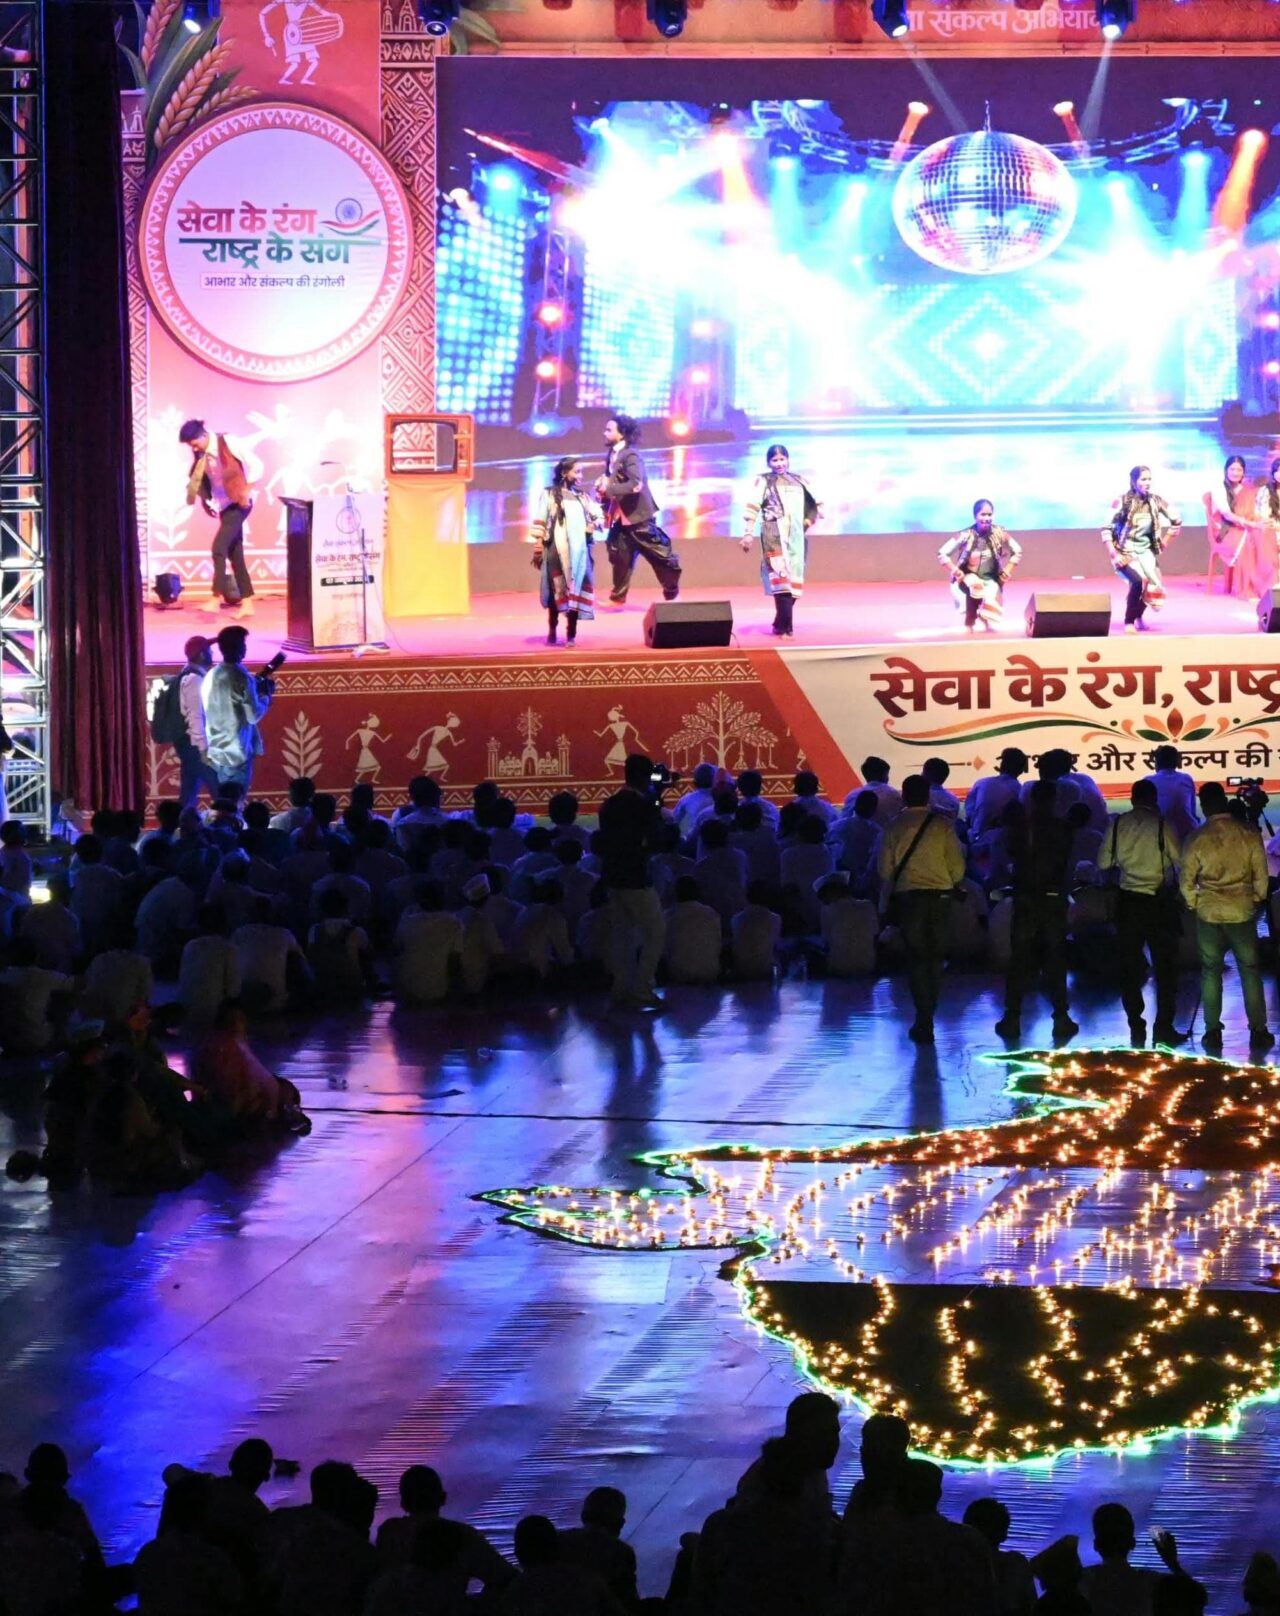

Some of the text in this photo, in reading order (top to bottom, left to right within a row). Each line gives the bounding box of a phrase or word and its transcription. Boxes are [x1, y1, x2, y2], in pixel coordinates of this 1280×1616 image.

[928, 5, 1009, 37] संकल्प
[176, 199, 317, 234] सेवा के रंग
[197, 231, 353, 269] राष्ट्र के संग
[203, 273, 346, 288] आभार और संकल्प की रंगोली
[870, 656, 996, 718] सेवा
[1003, 654, 1068, 708] के
[1076, 651, 1174, 709] रंग,
[1086, 743, 1137, 771] और
[1234, 741, 1273, 768] की
